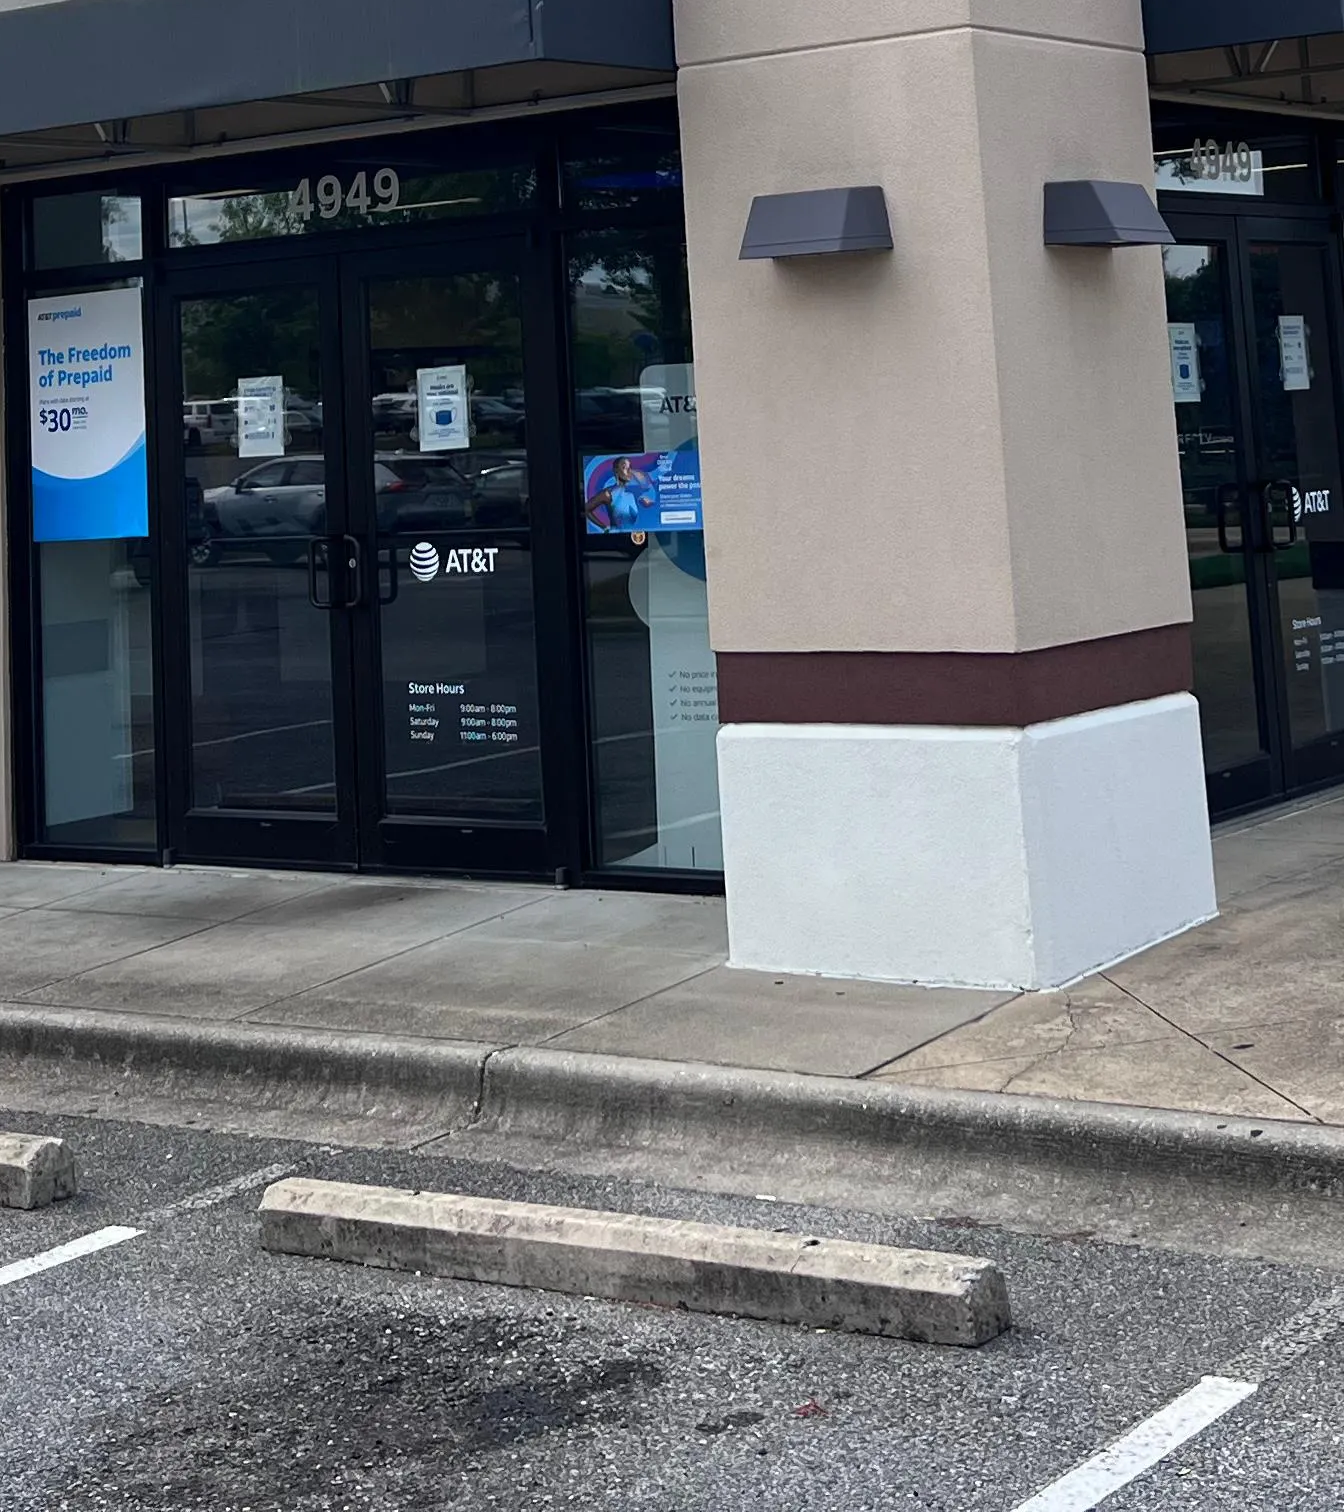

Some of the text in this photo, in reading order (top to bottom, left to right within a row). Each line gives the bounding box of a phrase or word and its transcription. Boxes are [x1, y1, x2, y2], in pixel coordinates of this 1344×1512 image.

[1190, 138, 1251, 182] 4949
[294, 168, 399, 220] 4949
[38, 342, 131, 365] The Freedom
[39, 364, 113, 388] of Prepaid
[39, 408, 71, 432] $30
[1304, 490, 1330, 513] AT&T
[445, 548, 498, 573] AT&T
[409, 682, 465, 694] Store Hours
[409, 703, 435, 713] Mon-Fri
[410, 717, 439, 727] Saturday
[411, 730, 434, 741] Sunday
